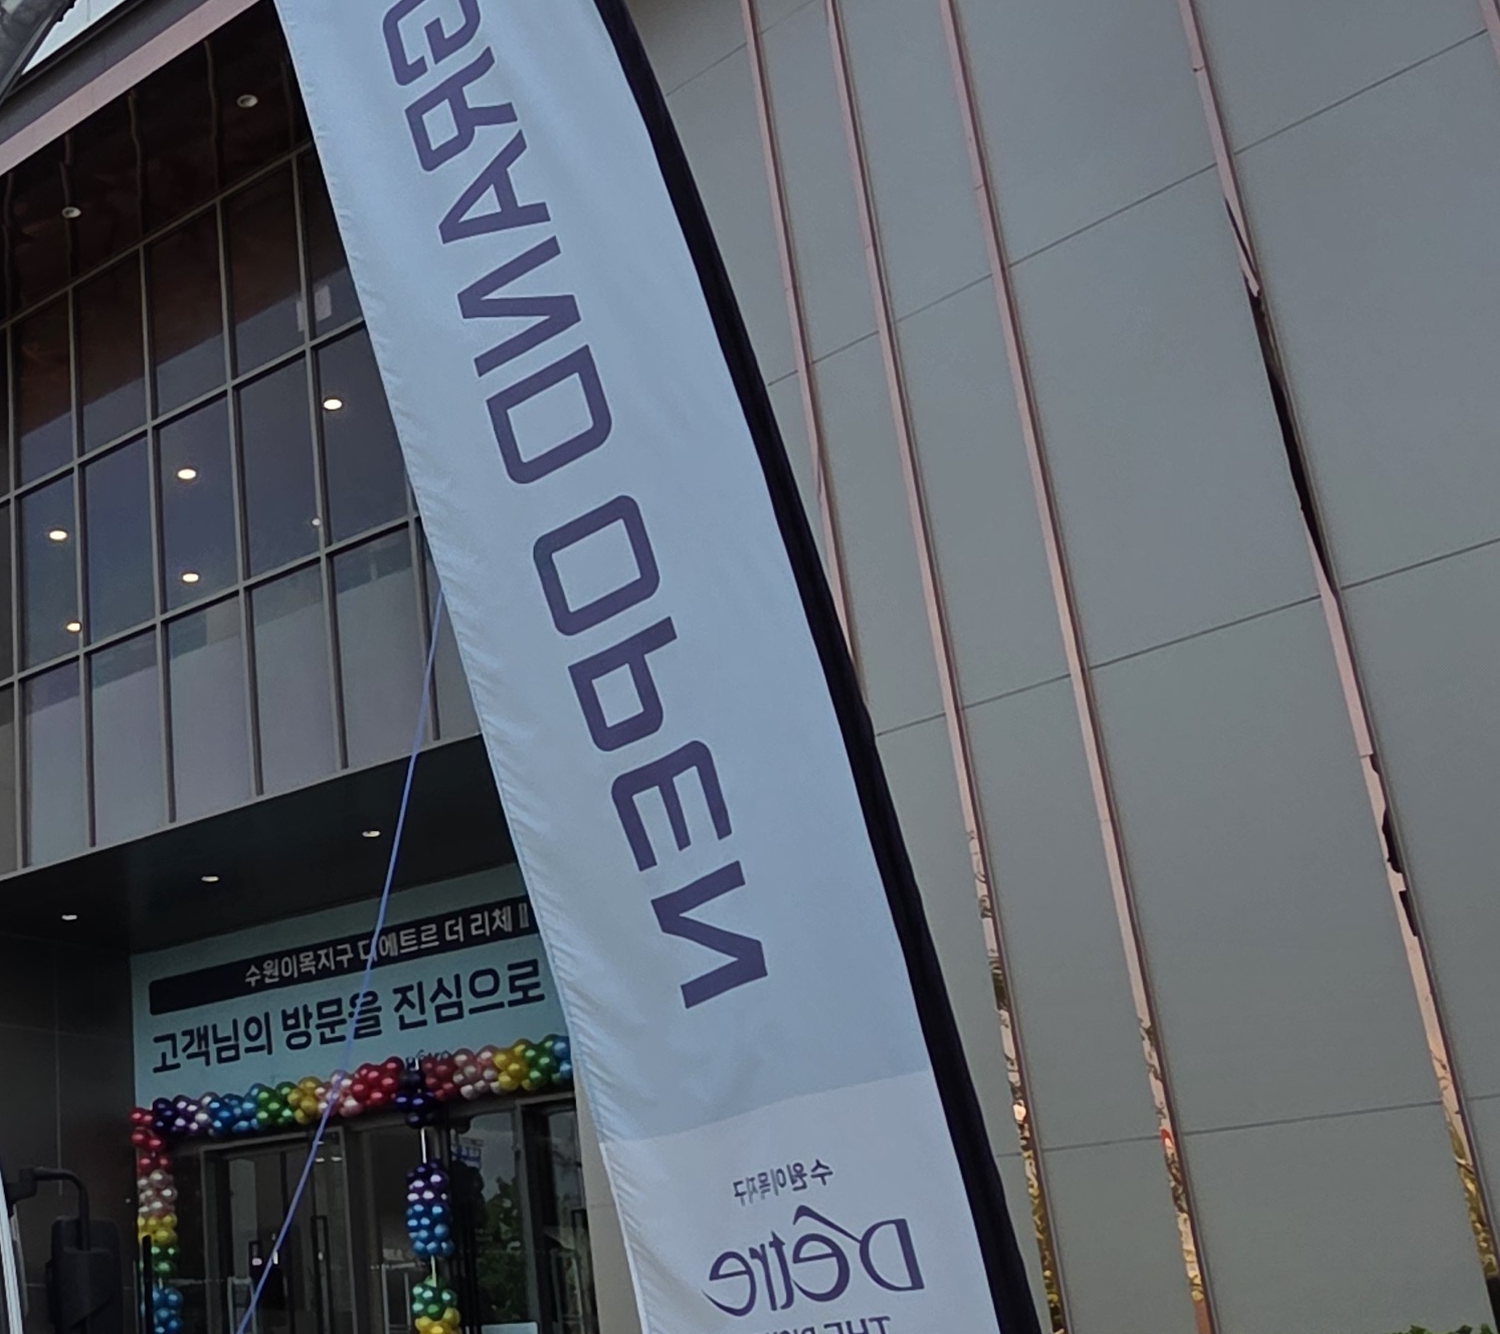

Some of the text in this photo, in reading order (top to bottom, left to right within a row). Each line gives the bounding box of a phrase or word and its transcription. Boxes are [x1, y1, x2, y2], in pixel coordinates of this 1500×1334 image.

[245, 944, 354, 988] 수원이목지구
[358, 923, 440, 962] 디에트르
[444, 919, 465, 943] 더
[470, 908, 513, 937] 리체
[152, 959, 546, 1074] 고객님의 방문을 진심으로
